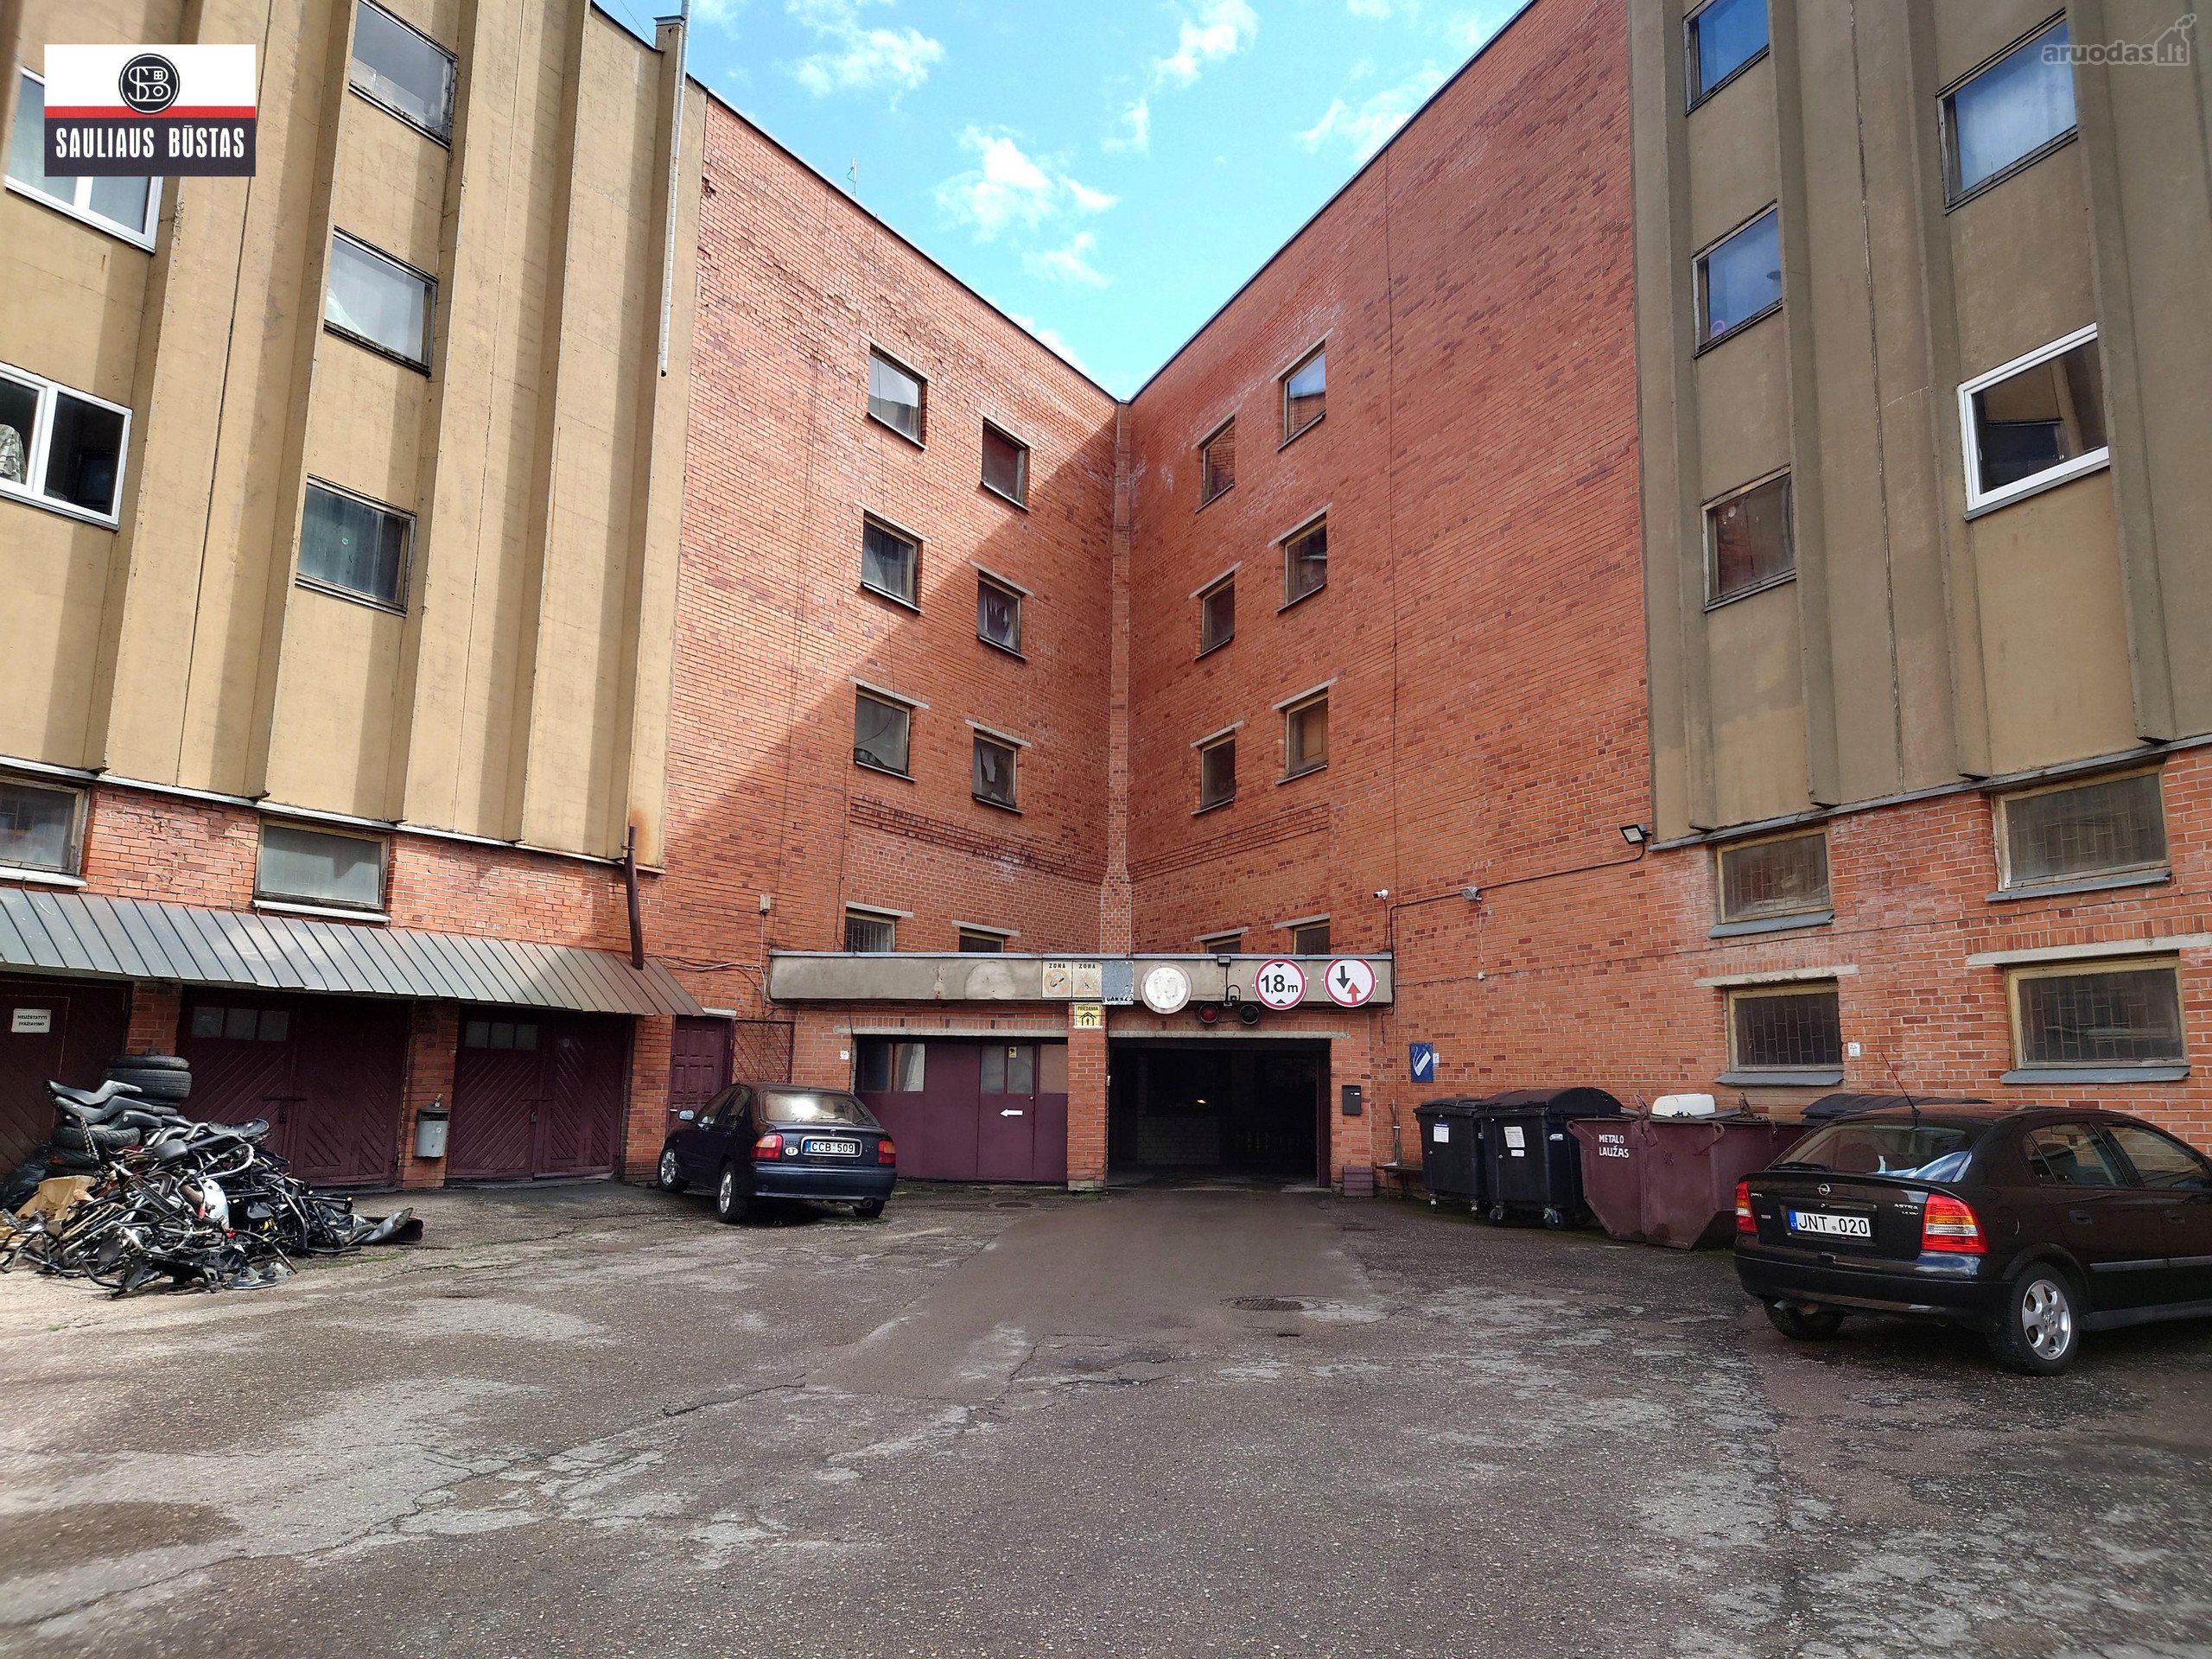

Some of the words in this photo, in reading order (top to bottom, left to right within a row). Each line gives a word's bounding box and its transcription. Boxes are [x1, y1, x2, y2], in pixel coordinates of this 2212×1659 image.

[1261, 974, 1286, 995] 1,8
[1287, 984, 1299, 993] m
[1599, 1134, 1624, 1144] METALO
[811, 1142, 831, 1152] CCB
[836, 1143, 855, 1153] 509
[1599, 1145, 1630, 1159] LAUŽAS
[1798, 1214, 1827, 1230] JNT
[1838, 1217, 1868, 1235] 020
